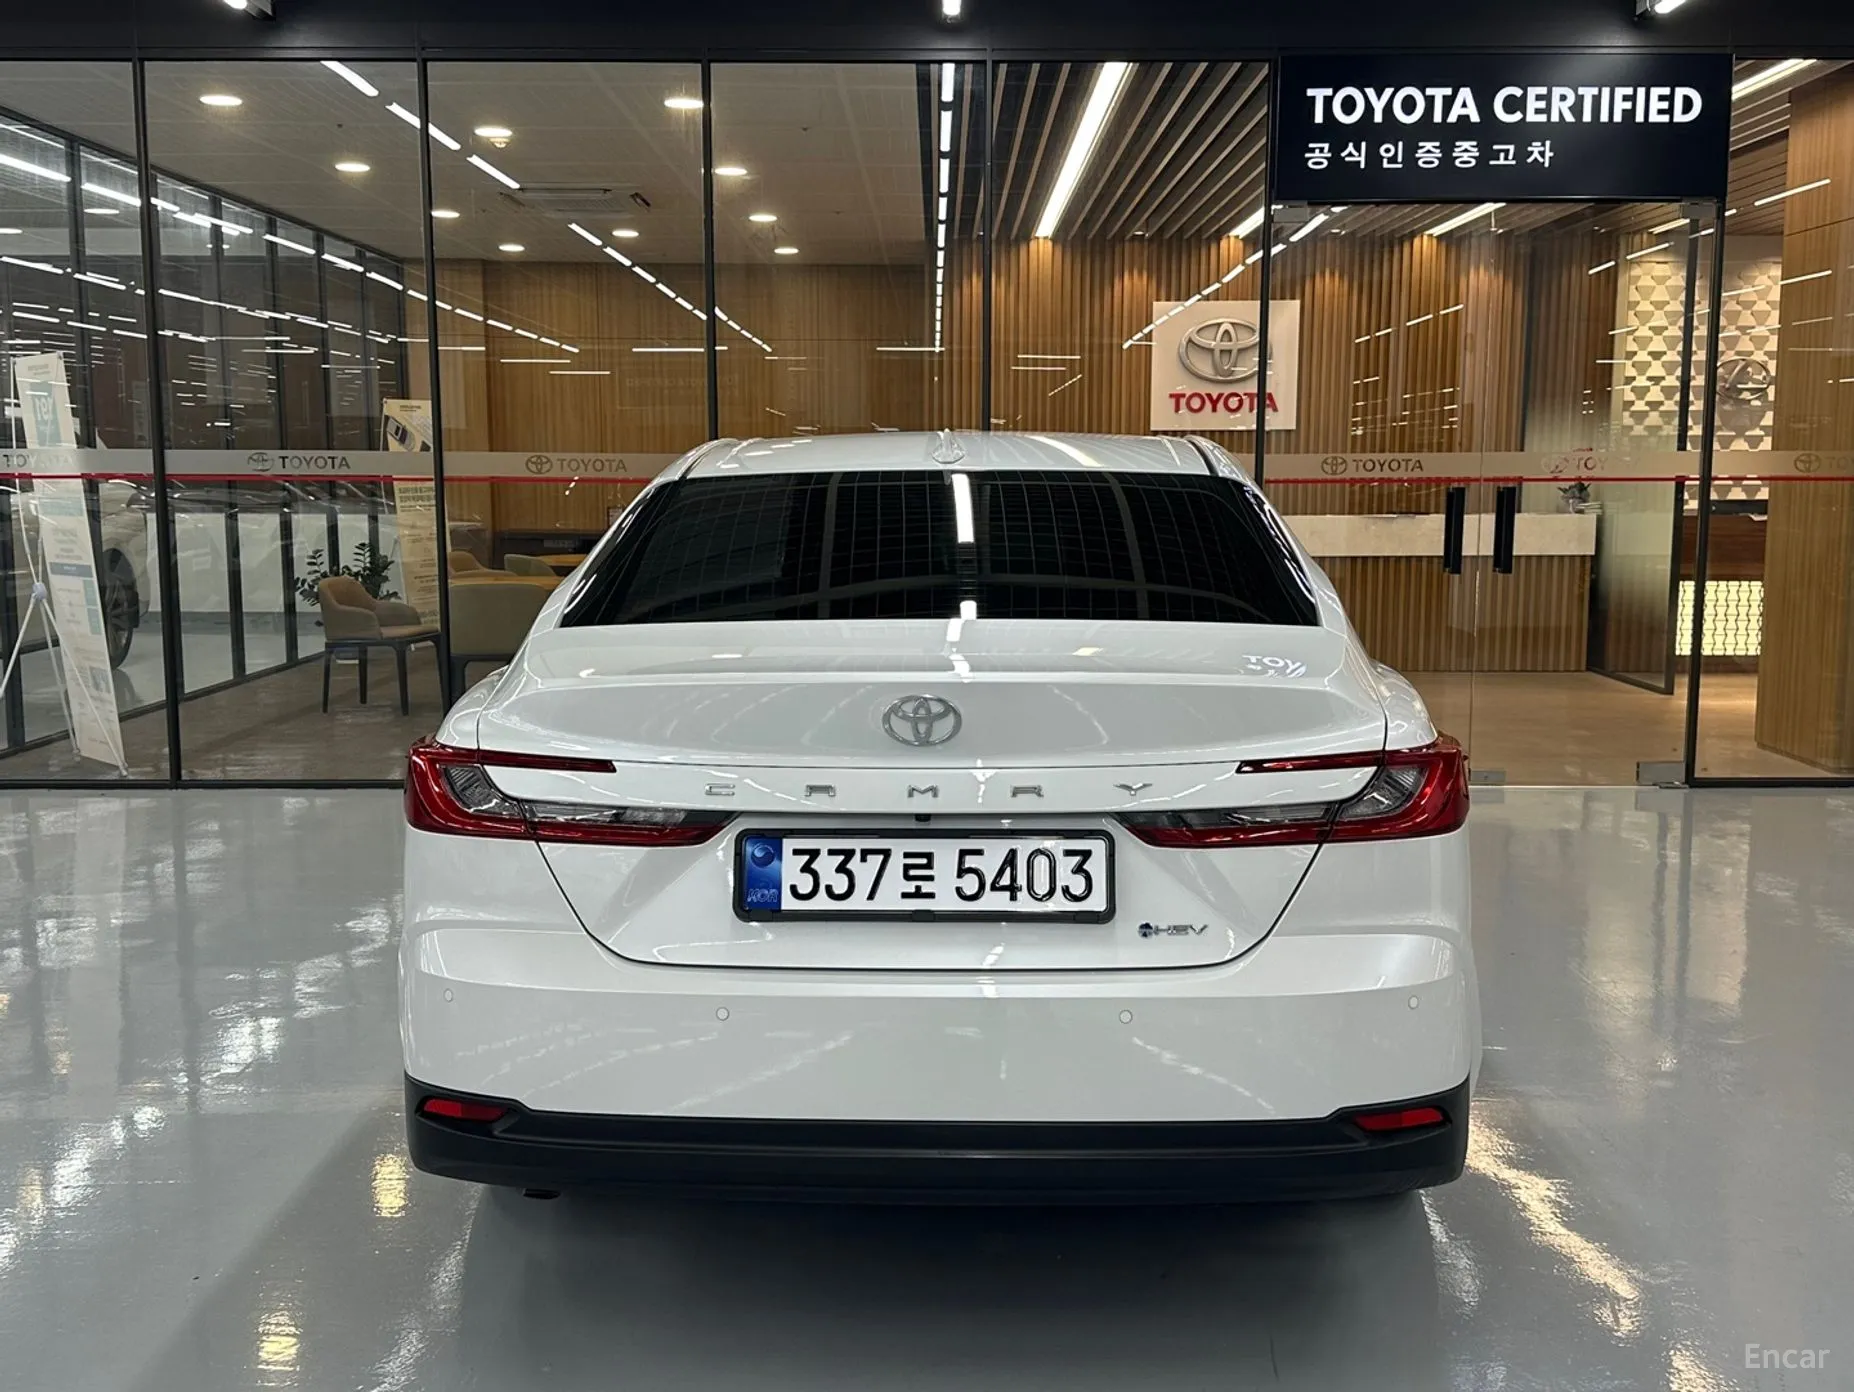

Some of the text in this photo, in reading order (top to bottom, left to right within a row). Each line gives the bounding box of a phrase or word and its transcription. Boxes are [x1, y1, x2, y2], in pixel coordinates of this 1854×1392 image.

[1306, 86, 1702, 124] TOYOTA CERTIFIED
[1168, 392, 1279, 413] TOYOTA
[278, 456, 351, 469] TOYOTA
[556, 458, 627, 472] TOYOTA
[1352, 458, 1424, 472] TOYOTA
[704, 783, 1153, 799] CAMRY
[789, 847, 1093, 903] 337로 5403
[747, 888, 779, 902] KOR
